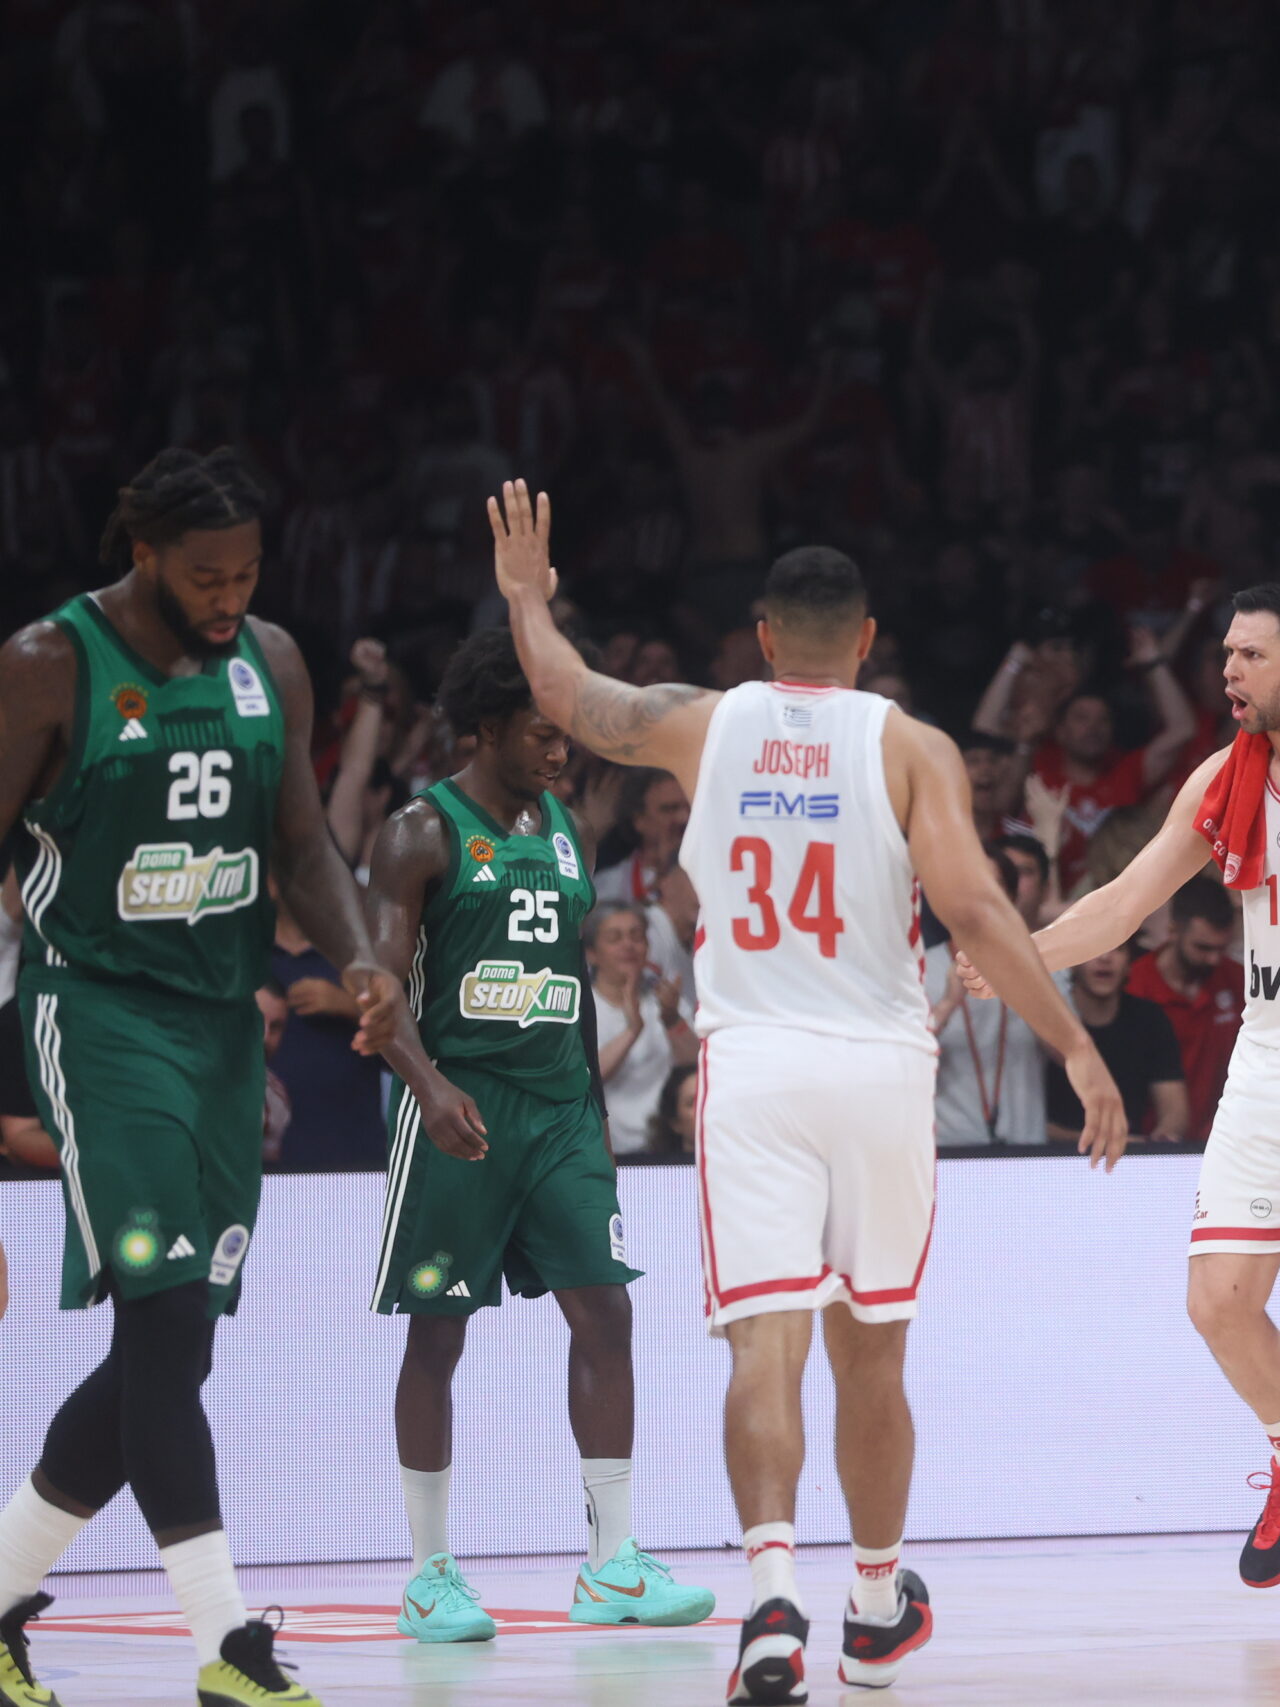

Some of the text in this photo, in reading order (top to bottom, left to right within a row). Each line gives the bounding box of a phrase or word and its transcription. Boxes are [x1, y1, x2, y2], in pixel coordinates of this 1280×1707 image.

[753, 739, 830, 778] JOSEPH
[167, 750, 233, 820] 26
[740, 791, 839, 818] FMS
[140, 852, 182, 870] pame
[508, 889, 559, 943] 25
[730, 836, 844, 959] 34
[481, 967, 516, 980] pame
